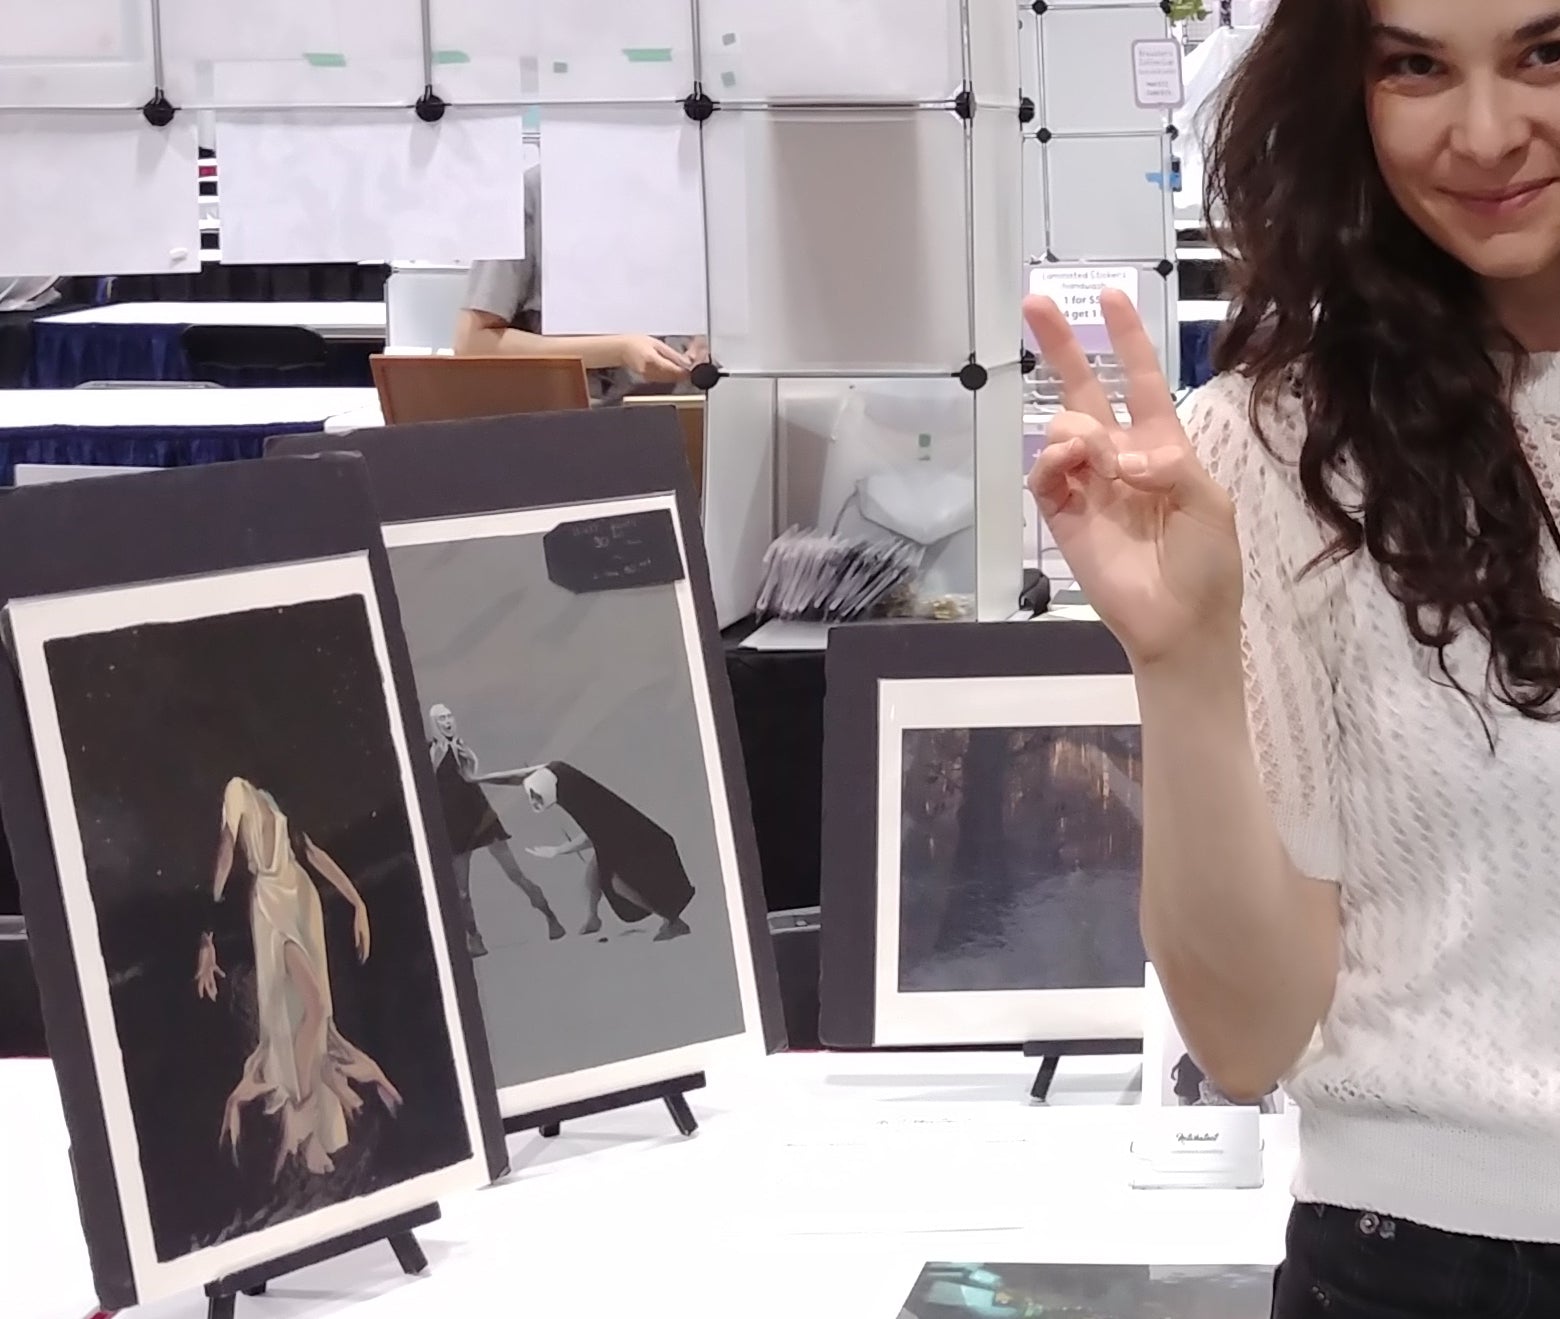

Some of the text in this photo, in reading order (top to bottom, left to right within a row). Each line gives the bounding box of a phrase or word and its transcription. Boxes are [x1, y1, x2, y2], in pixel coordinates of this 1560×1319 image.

[1064, 296, 1069, 304] 1
[1072, 295, 1087, 304] for
[1071, 309, 1089, 320] get
